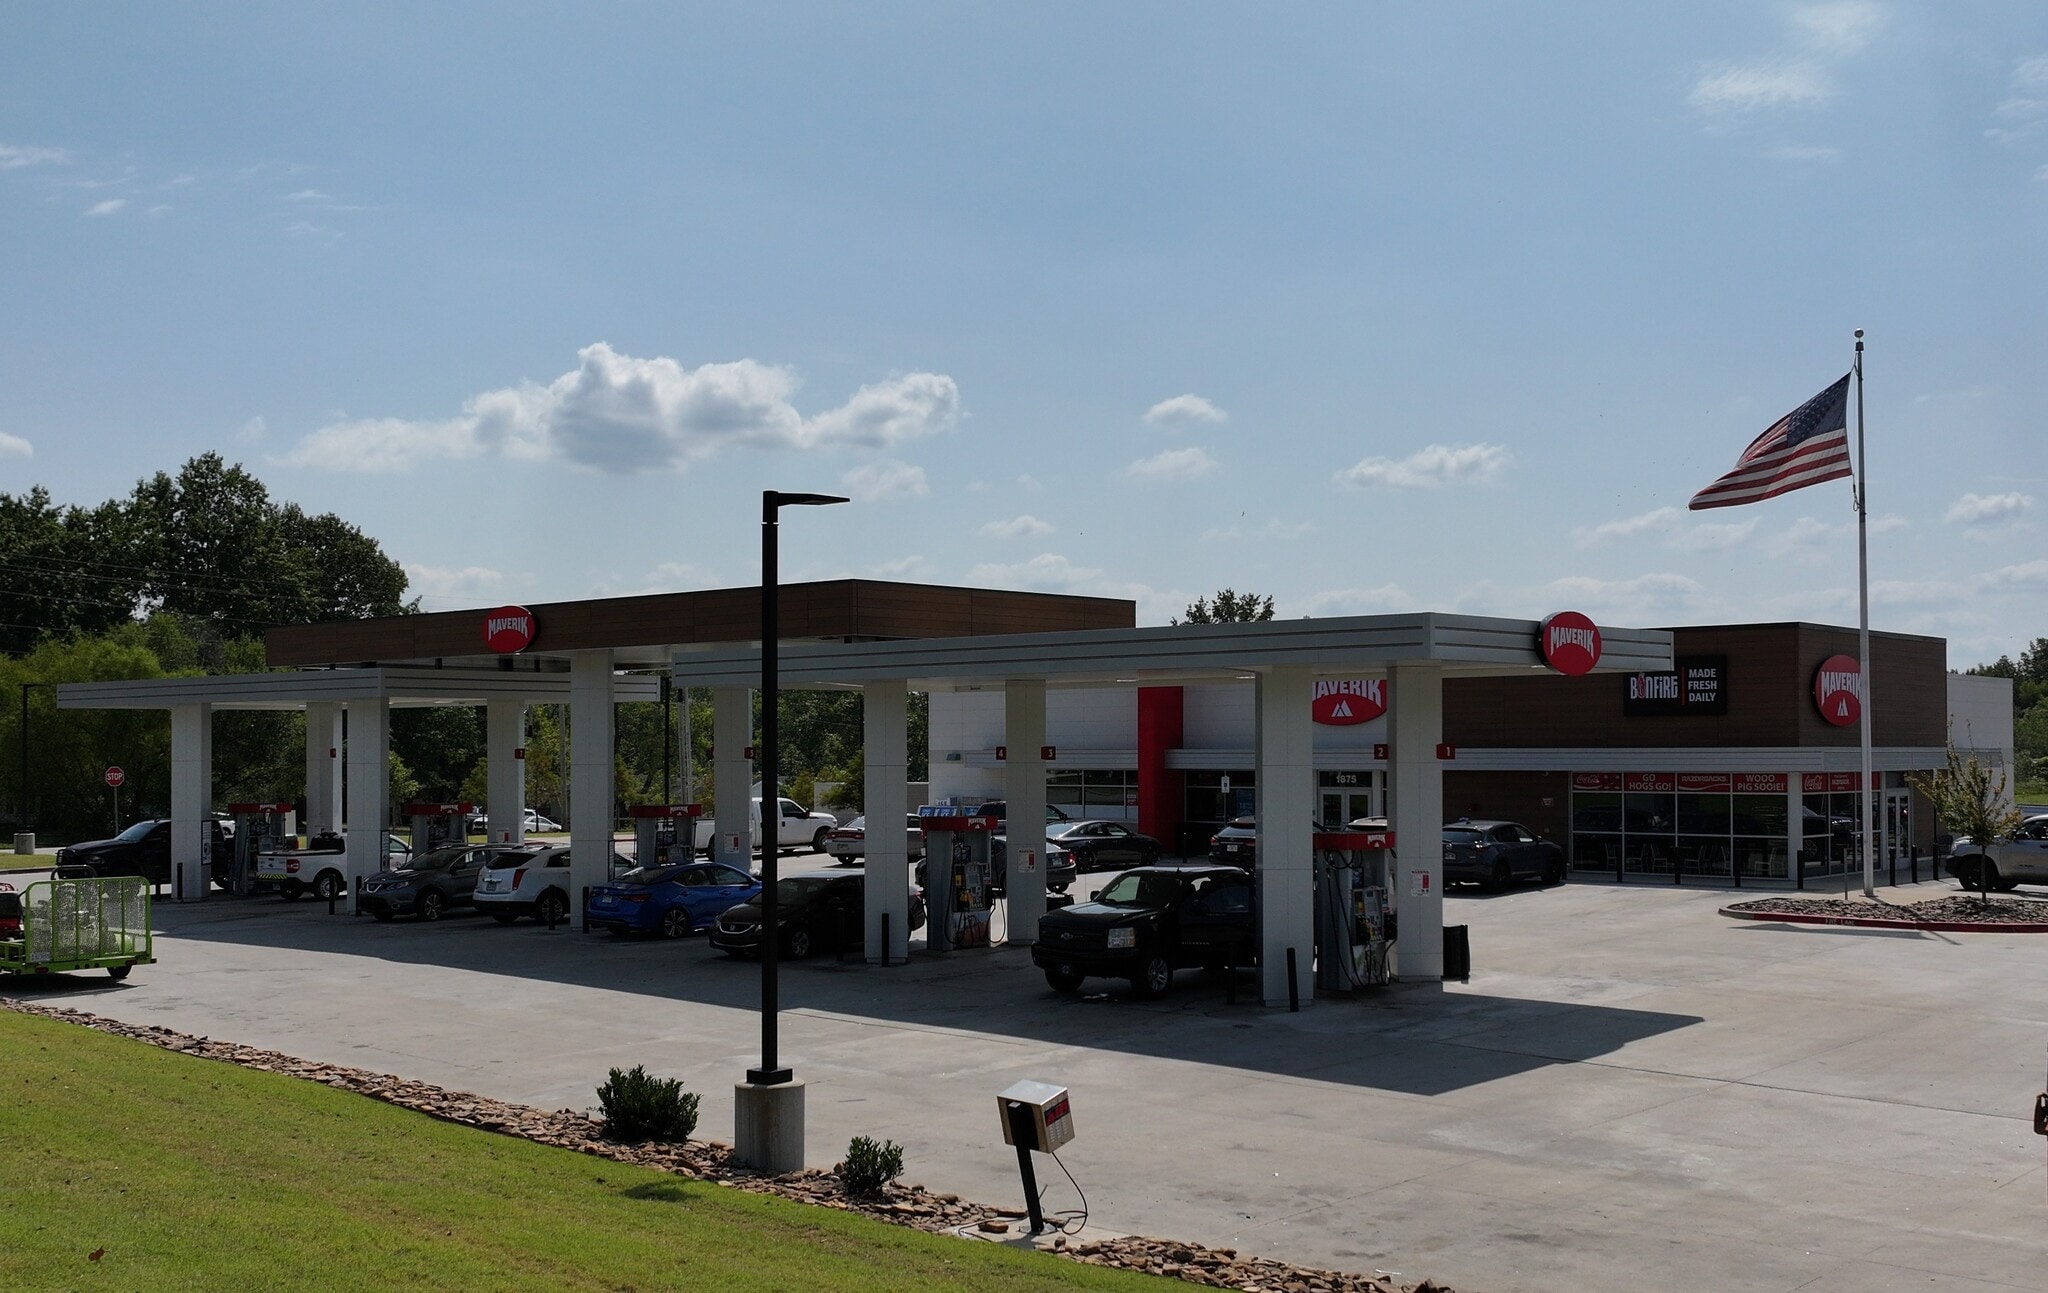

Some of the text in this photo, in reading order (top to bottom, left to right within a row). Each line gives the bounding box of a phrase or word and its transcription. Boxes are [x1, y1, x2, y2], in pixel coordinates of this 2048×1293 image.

[487, 616, 529, 641] MAVERIK
[1550, 626, 1595, 660] MAVERIK
[1688, 668, 1717, 679] MADE
[1687, 680, 1718, 691] FRESH
[1821, 671, 1862, 707] MAVERIK
[1312, 679, 1382, 709] AVERIK
[1688, 692, 1717, 702] DAILY
[998, 749, 1004, 758] 4
[1047, 749, 1053, 758] 3
[1377, 747, 1384, 757] 2
[1445, 746, 1451, 757] 1
[107, 772, 123, 781] STOP
[1336, 775, 1357, 784] 1875
[1641, 773, 1656, 782] GO
[1745, 774, 1775, 782] WOOO
[1628, 782, 1673, 791] HOGS GO!
[1737, 783, 1752, 791] PIG
